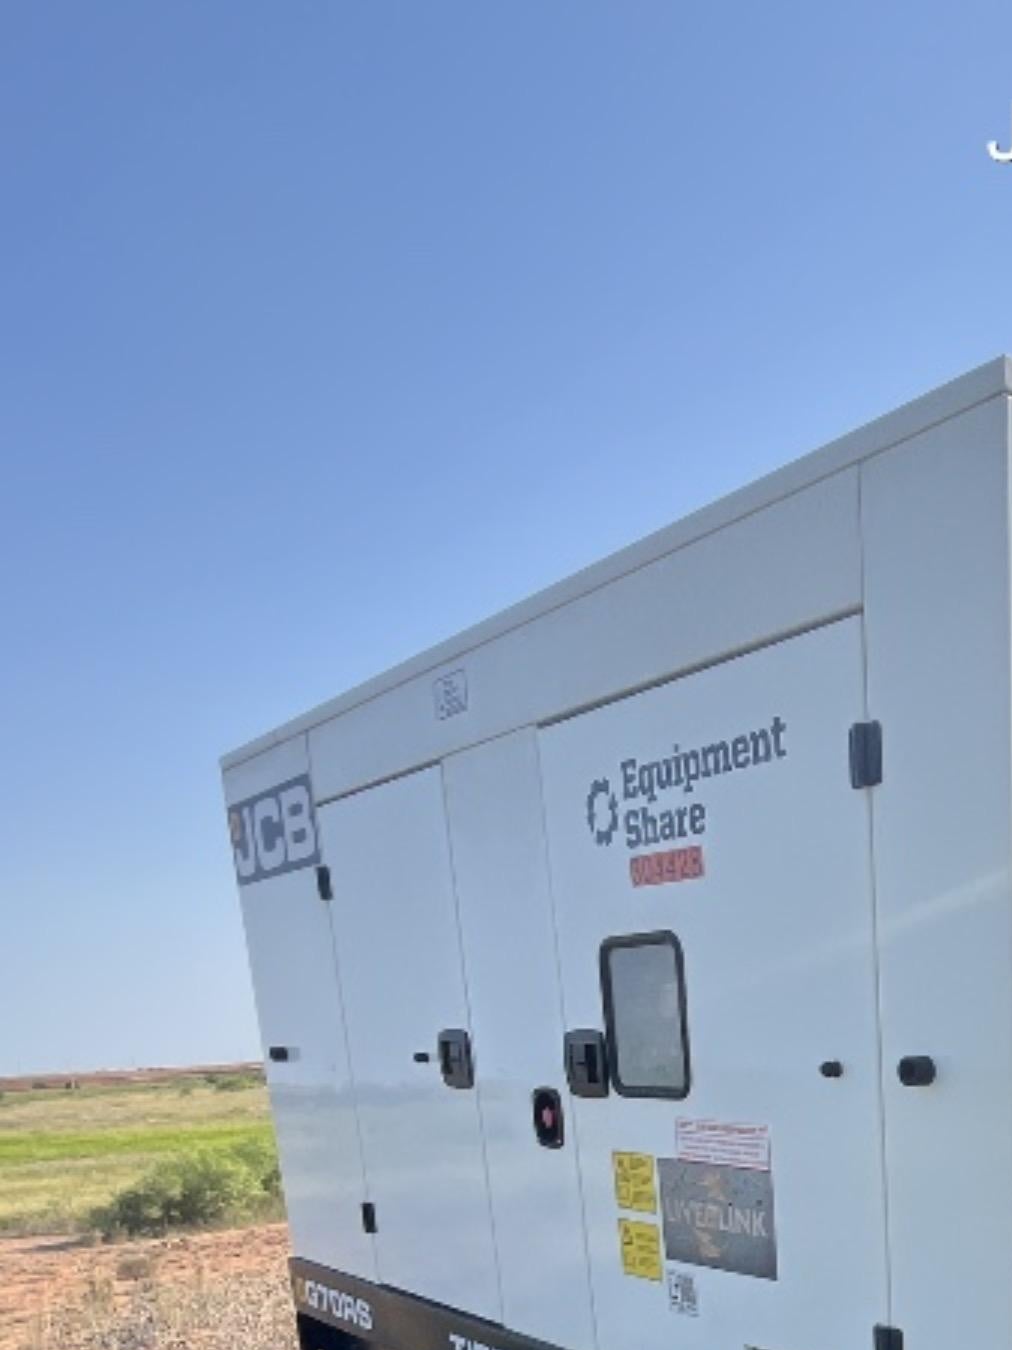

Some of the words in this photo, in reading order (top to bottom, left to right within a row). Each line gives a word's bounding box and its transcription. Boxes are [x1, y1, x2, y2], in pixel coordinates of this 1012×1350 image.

[620, 716, 787, 804] Equipment
[235, 784, 316, 878] JCB
[624, 802, 707, 849] Share
